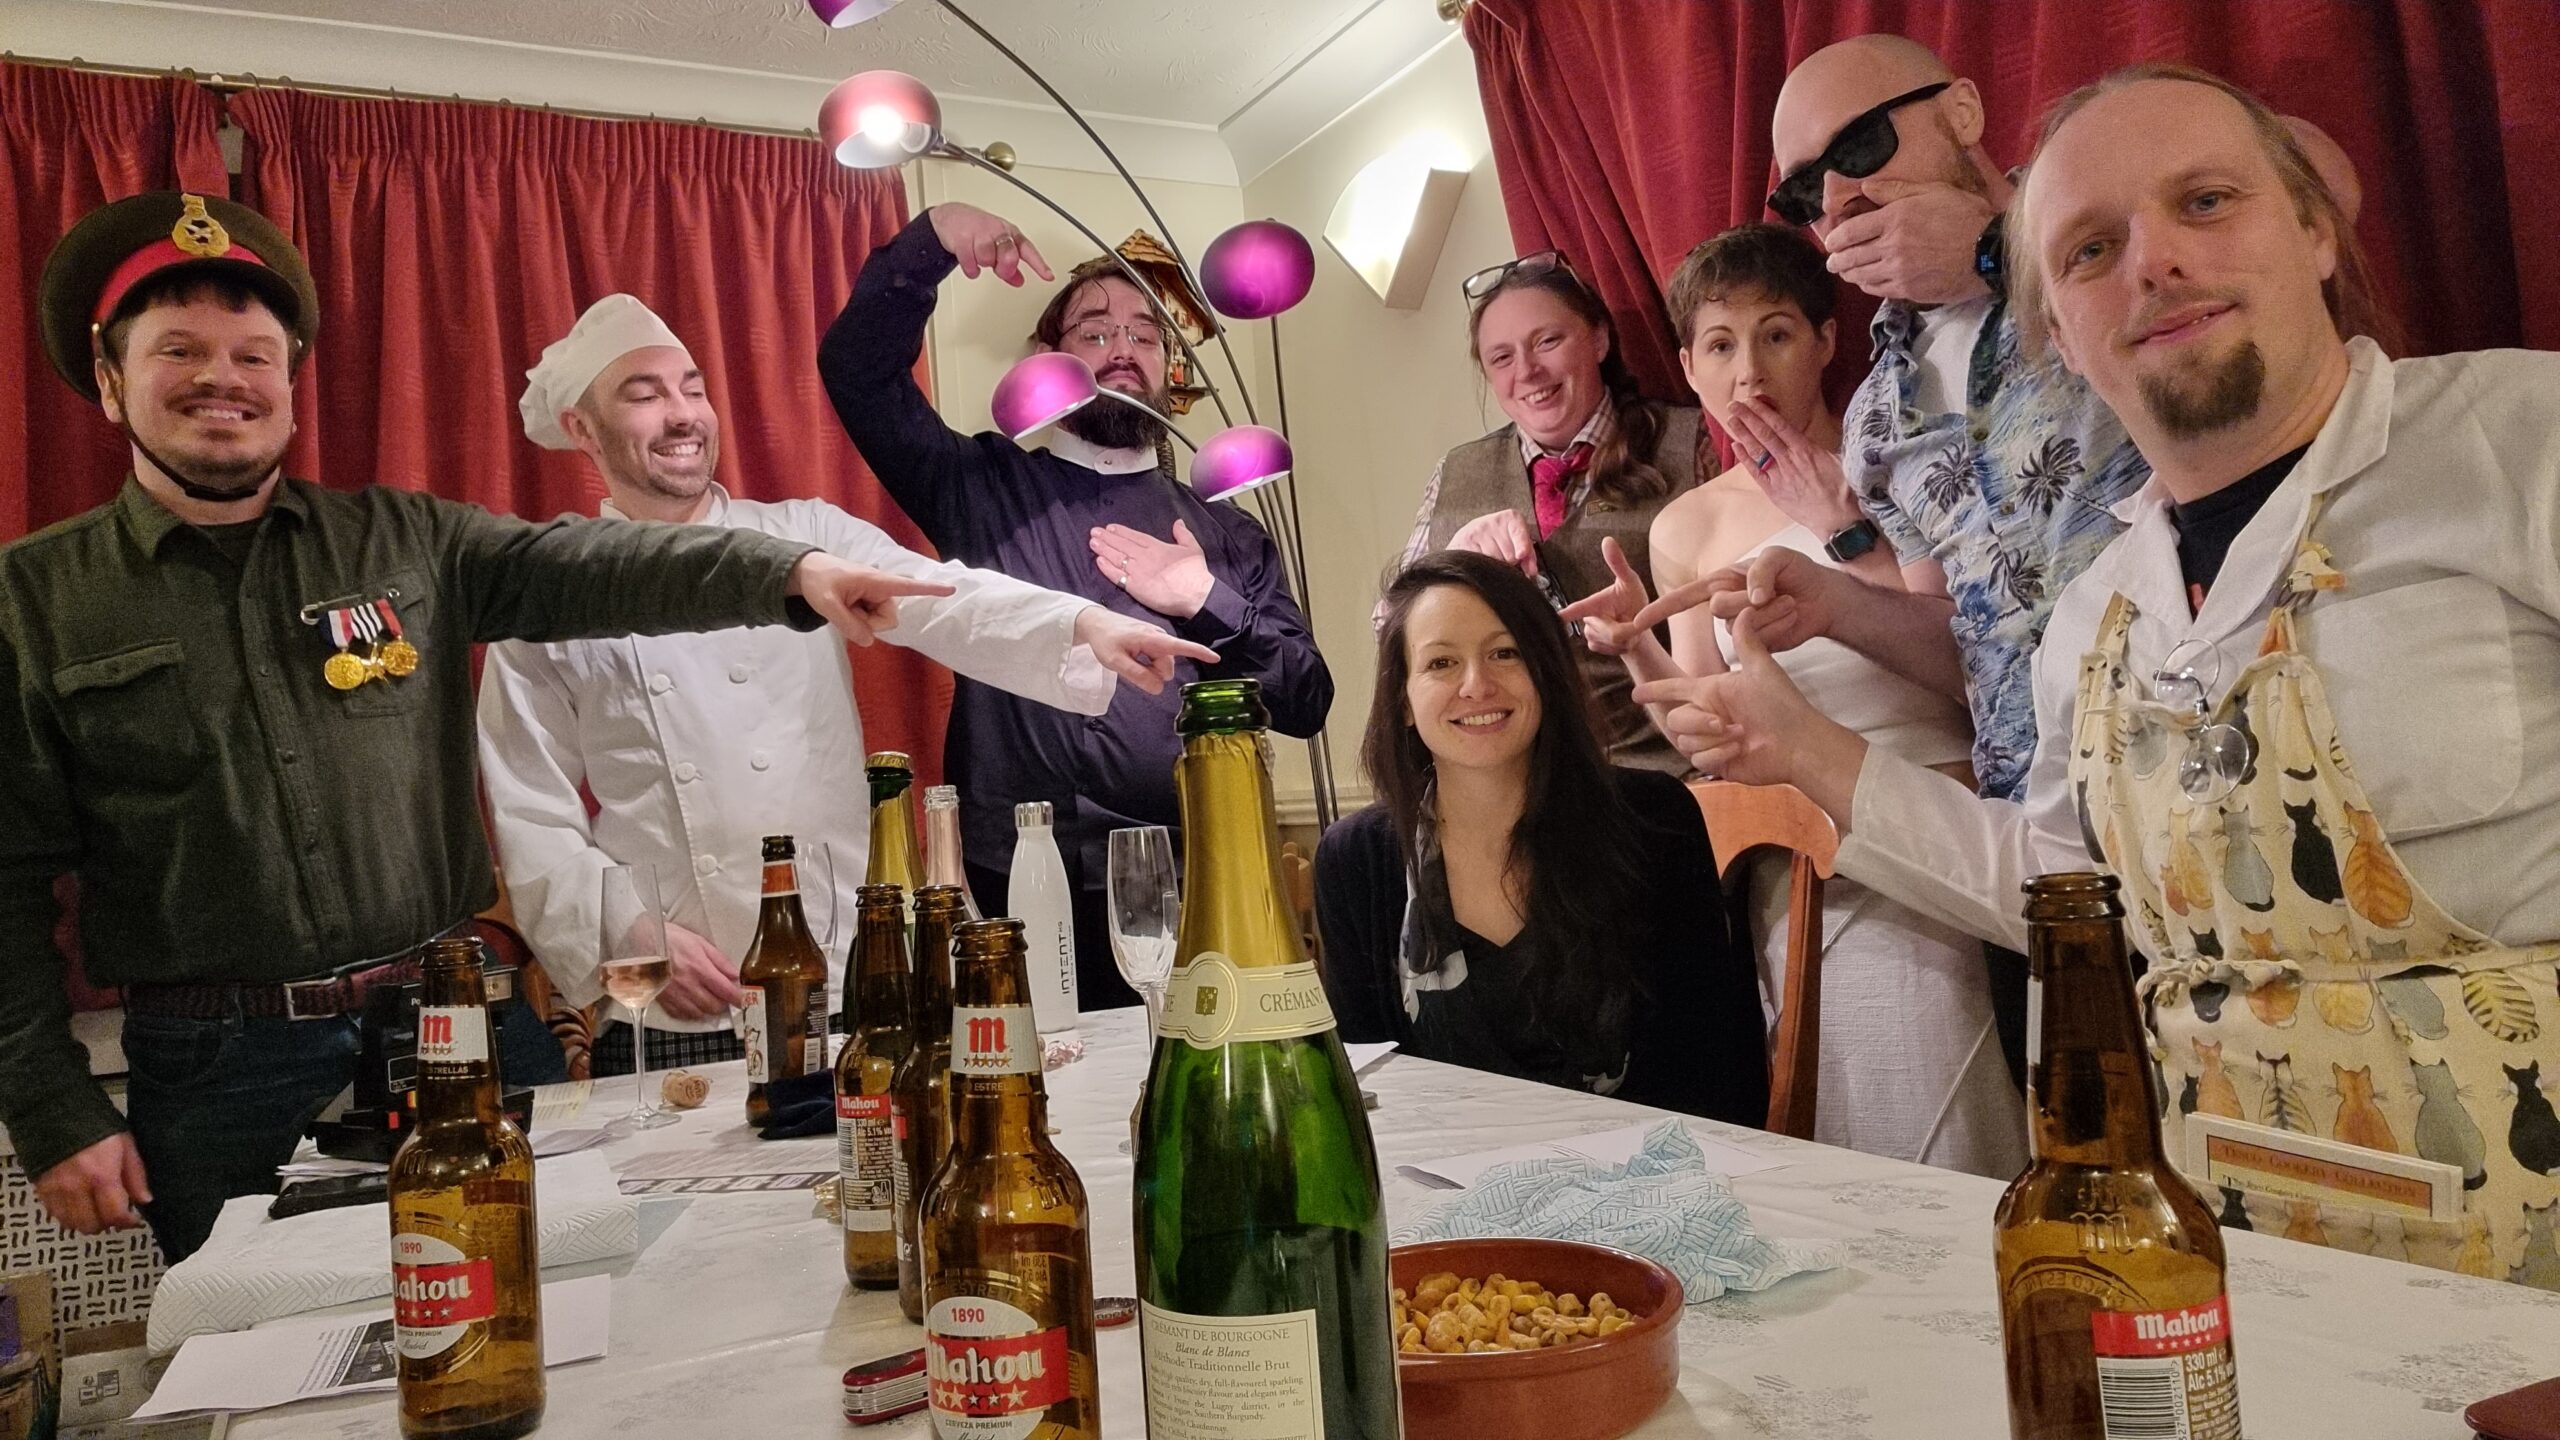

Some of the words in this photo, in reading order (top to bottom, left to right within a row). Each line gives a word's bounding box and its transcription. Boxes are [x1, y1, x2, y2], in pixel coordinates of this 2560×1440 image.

[1059, 933, 1070, 995] INTENT
[841, 1096, 880, 1109] Mahou
[400, 1242, 422, 1254] 1890
[951, 1308, 985, 1323] 1890
[2134, 1308, 2220, 1340] Mahou
[1193, 1329, 1208, 1341] DE
[1210, 1328, 1290, 1343] BOURGOGNE
[1176, 1342, 1200, 1355] Blanc
[1202, 1346, 1214, 1357] de
[1217, 1346, 1250, 1358] Blancs
[1187, 1358, 1261, 1372] Traditionnelle
[1265, 1360, 1290, 1371] Brut
[2185, 1352, 2205, 1372] 330
[2206, 1347, 2218, 1367] ml
[1269, 1376, 1304, 1389] sparkling
[2188, 1373, 2206, 1392] Alc
[2207, 1364, 2226, 1387] 5.1%
[1235, 1389, 1249, 1398] and
[1251, 1389, 1277, 1400] elegant
[975, 1420, 1012, 1429] PREMIUM
